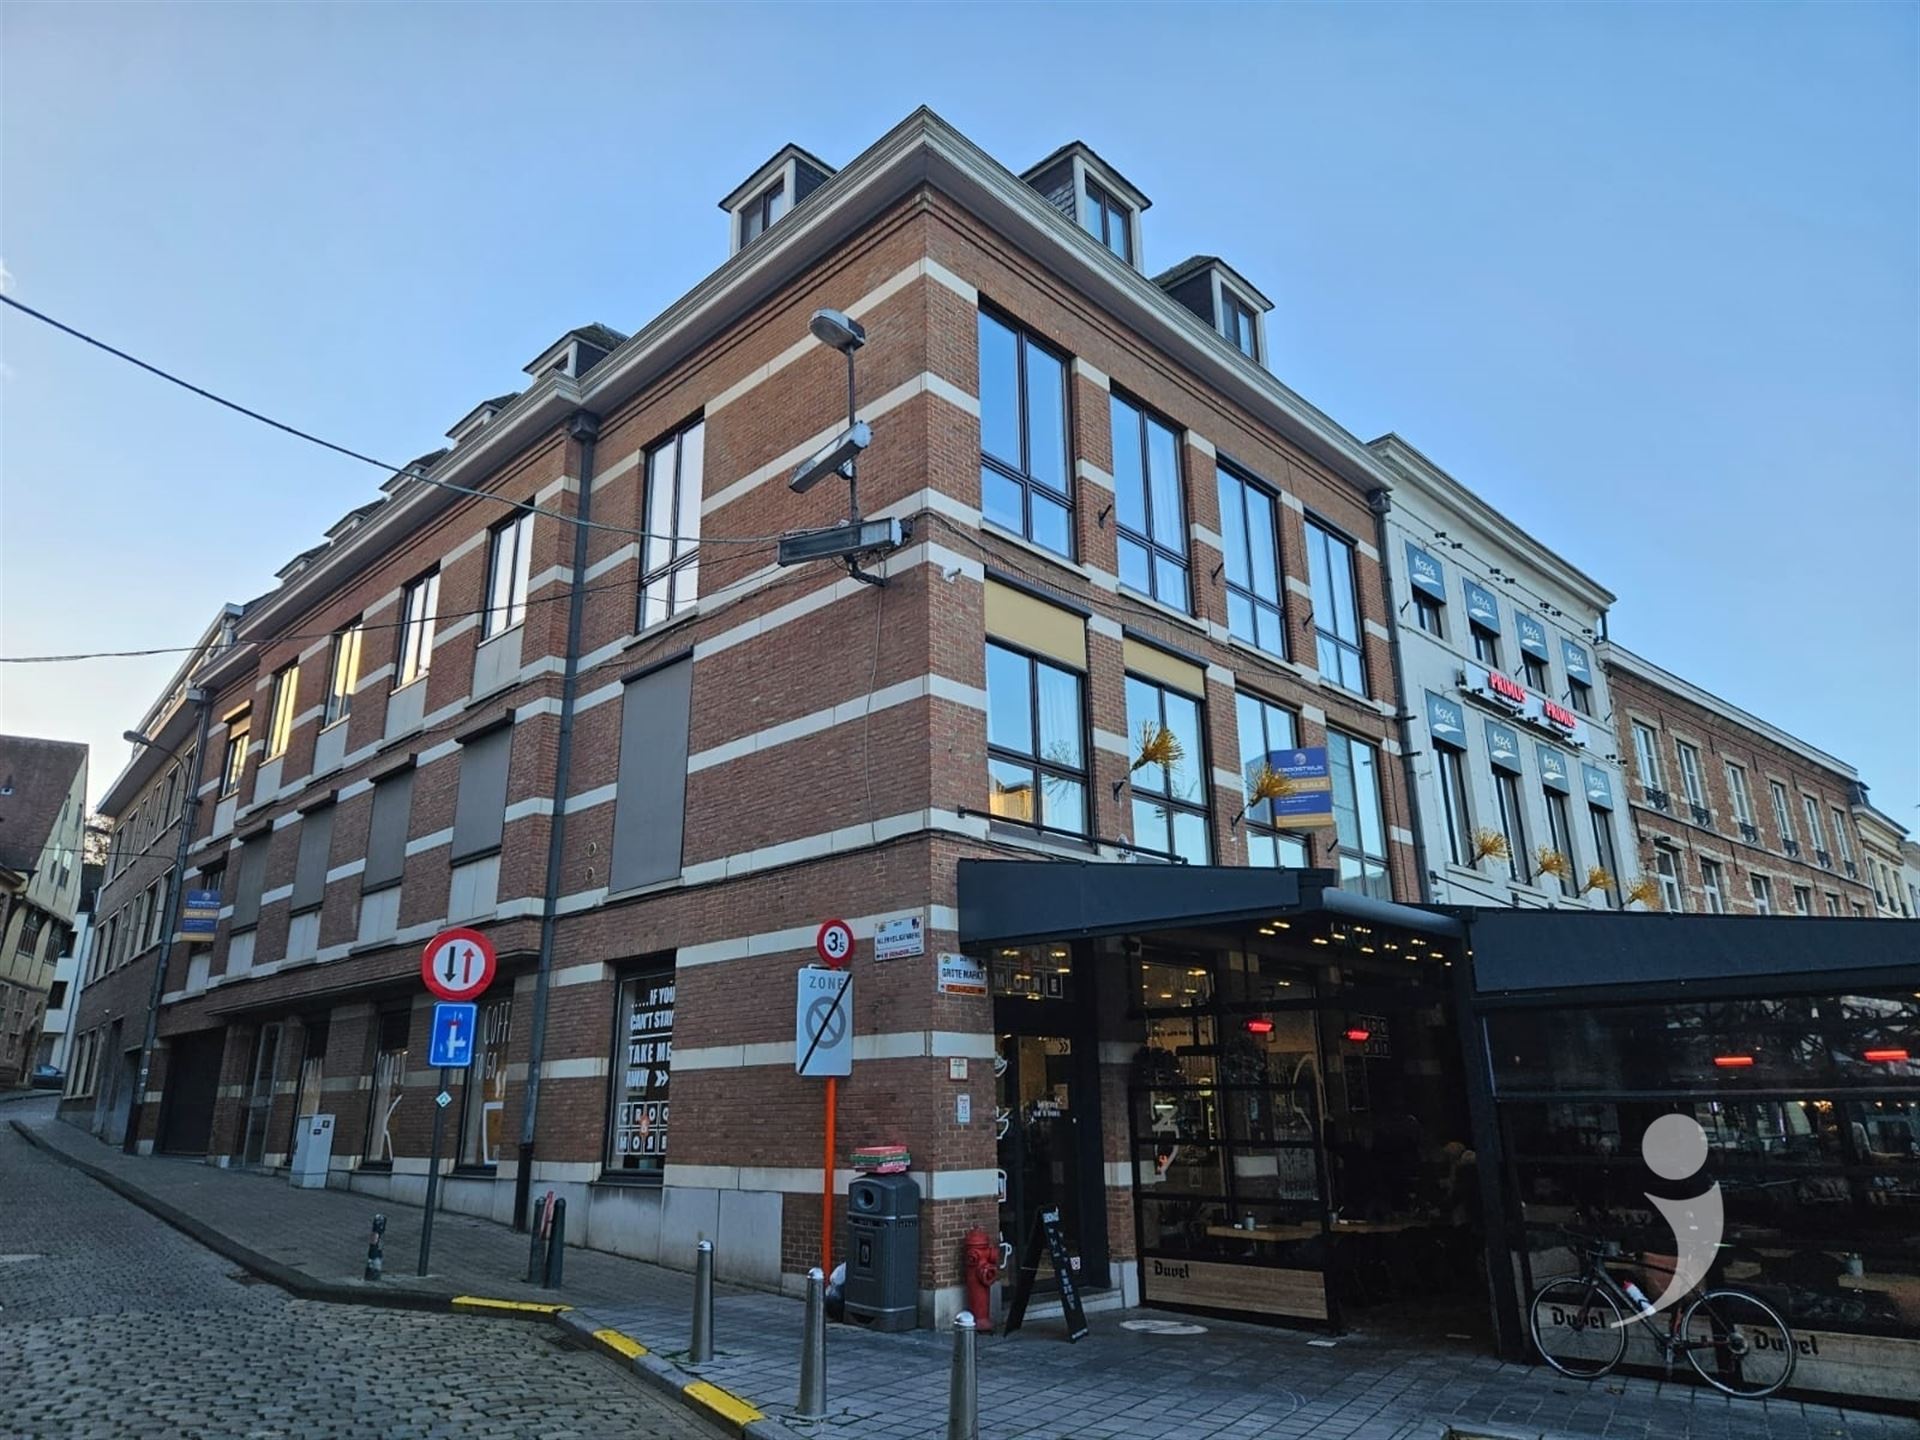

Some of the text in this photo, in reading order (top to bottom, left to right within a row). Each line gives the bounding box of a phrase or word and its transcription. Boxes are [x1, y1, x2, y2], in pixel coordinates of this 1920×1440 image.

[1490, 672, 1526, 704] PRIMUS
[1545, 700, 1577, 730] PRIMUS
[809, 976, 845, 990] ZONE
[659, 986, 676, 1004] YOU
[630, 1012, 654, 1031] CAN'T
[629, 1041, 673, 1065] TAKE ME
[626, 1069, 649, 1088] AWAY
[1154, 1261, 1190, 1279] Duvel
